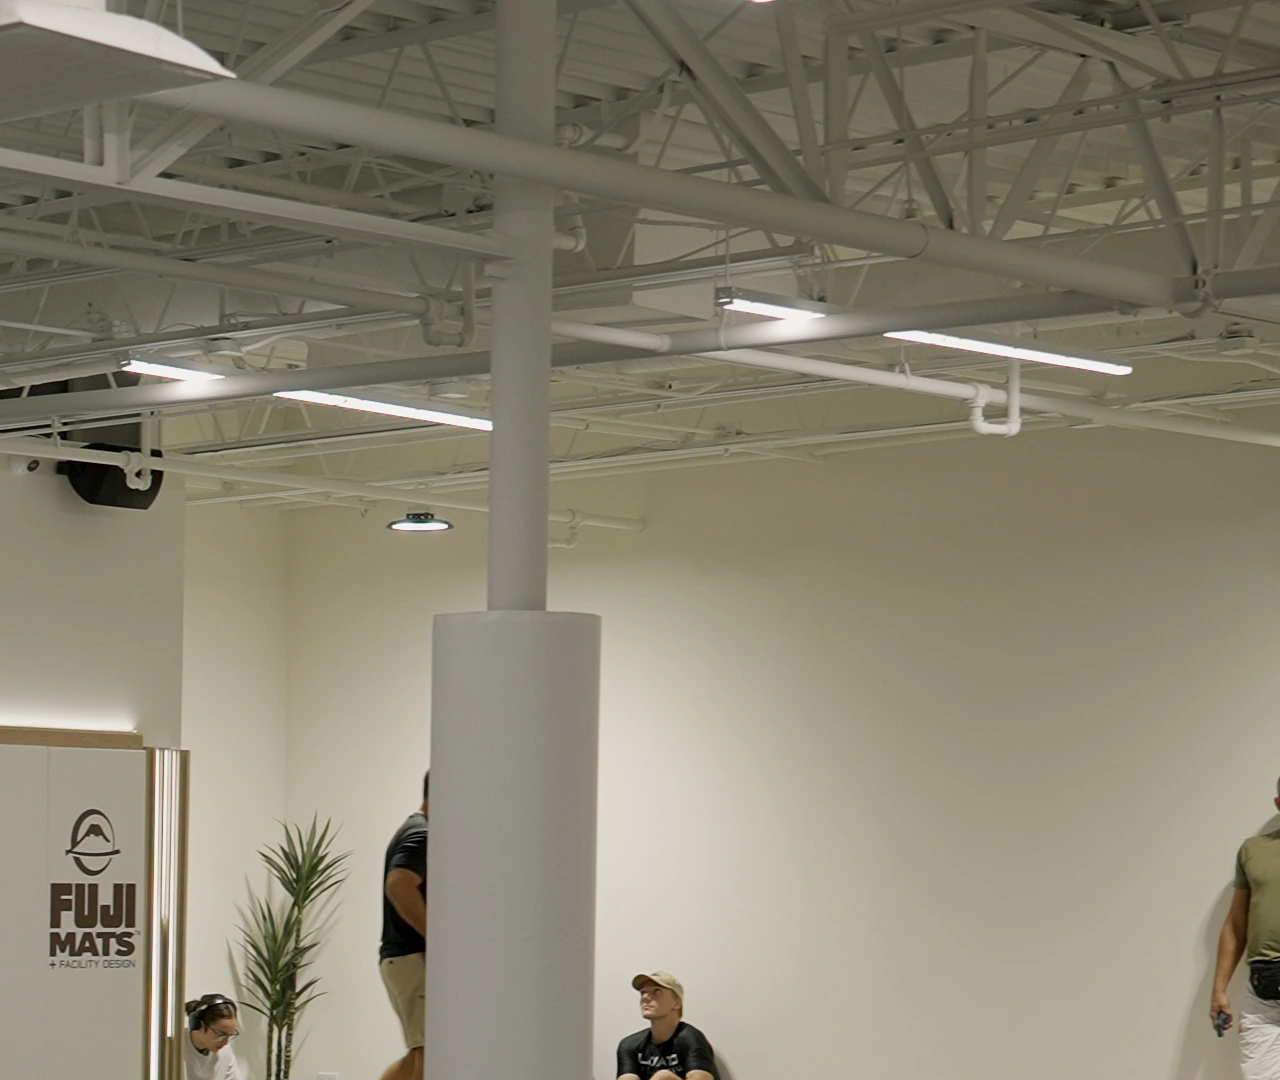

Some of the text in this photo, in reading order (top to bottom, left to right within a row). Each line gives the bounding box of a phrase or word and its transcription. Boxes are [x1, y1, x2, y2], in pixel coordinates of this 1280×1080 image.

[49, 882, 137, 929] FUJI
[58, 959, 101, 969] FACILITY
[102, 959, 137, 969] DESIGN
